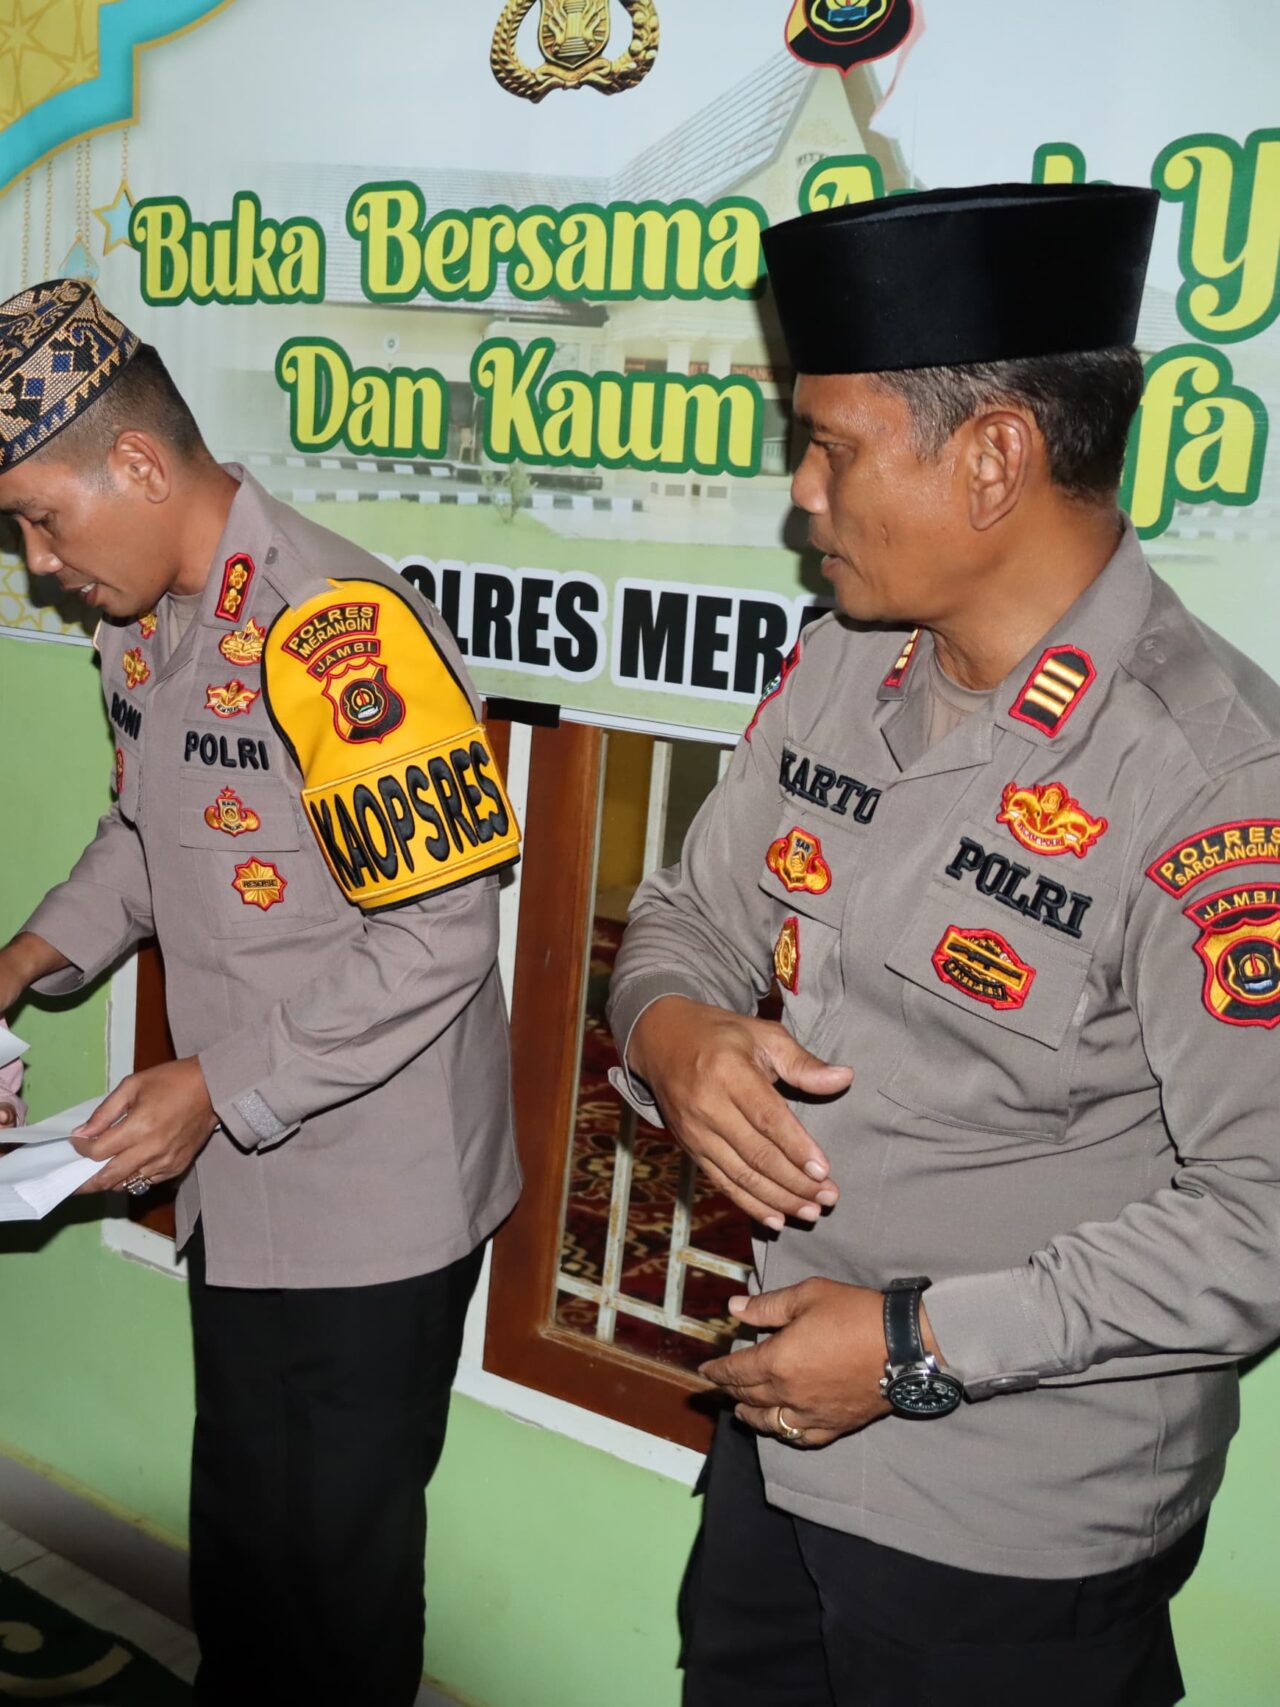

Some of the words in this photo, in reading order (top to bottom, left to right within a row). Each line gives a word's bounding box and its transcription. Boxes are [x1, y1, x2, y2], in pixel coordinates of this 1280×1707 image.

[131, 192, 325, 305] Buka
[350, 182, 767, 303] Bersama
[276, 337, 448, 460] Dan
[470, 337, 763, 478] Kaum
[288, 606, 374, 651] POLRES
[299, 617, 371, 658] MERANGIN
[620, 587, 834, 694] MER
[317, 641, 371, 673] JAMBI
[184, 730, 270, 771] POLRI
[309, 740, 509, 892] KAOPSRES
[1160, 826, 1280, 880] POLRES
[1175, 842, 1279, 887] SAROLANGUN
[945, 836, 1093, 939] POLRI
[1204, 890, 1277, 920] JAMBI
